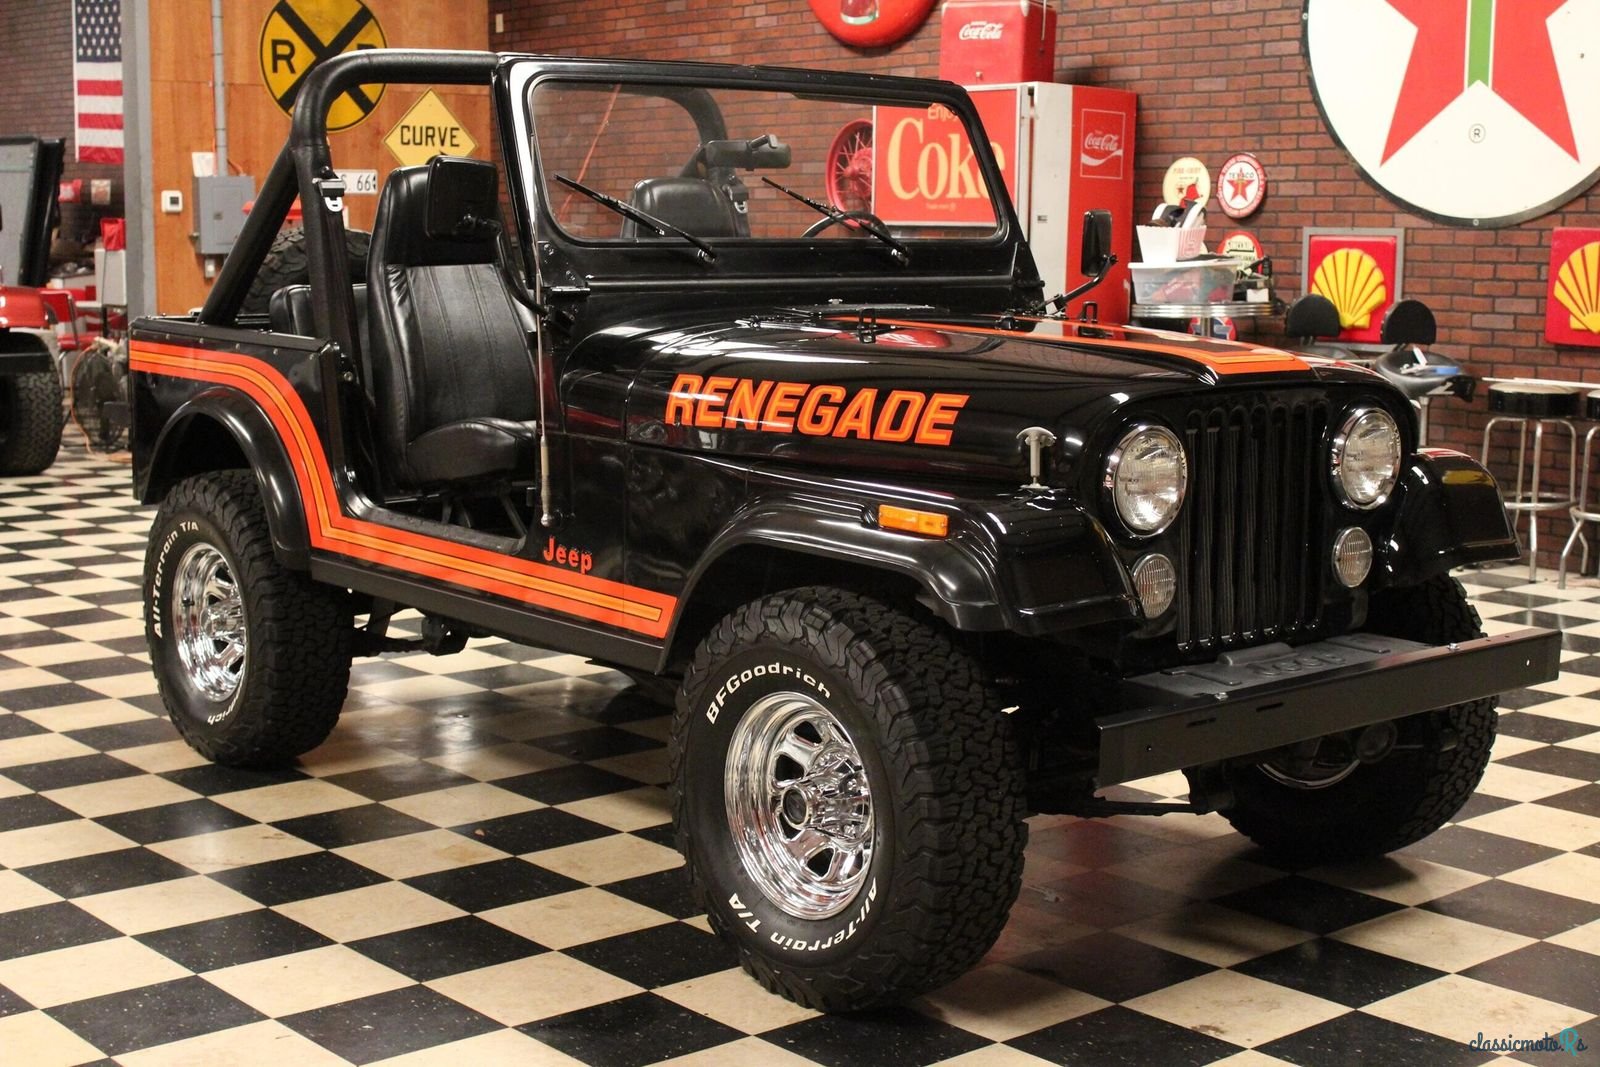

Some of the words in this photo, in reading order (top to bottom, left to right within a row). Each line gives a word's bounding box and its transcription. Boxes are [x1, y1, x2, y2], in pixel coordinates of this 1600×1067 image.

[400, 125, 460, 148] CURVE
[665, 374, 970, 446] RENEGADE
[152, 528, 179, 640] All-Terrain
[180, 521, 200, 532] T/A
[543, 535, 592, 575] Jeep
[706, 662, 831, 725] BFGoodrich
[728, 893, 762, 933] T/A
[770, 877, 877, 951] All-Terrain
